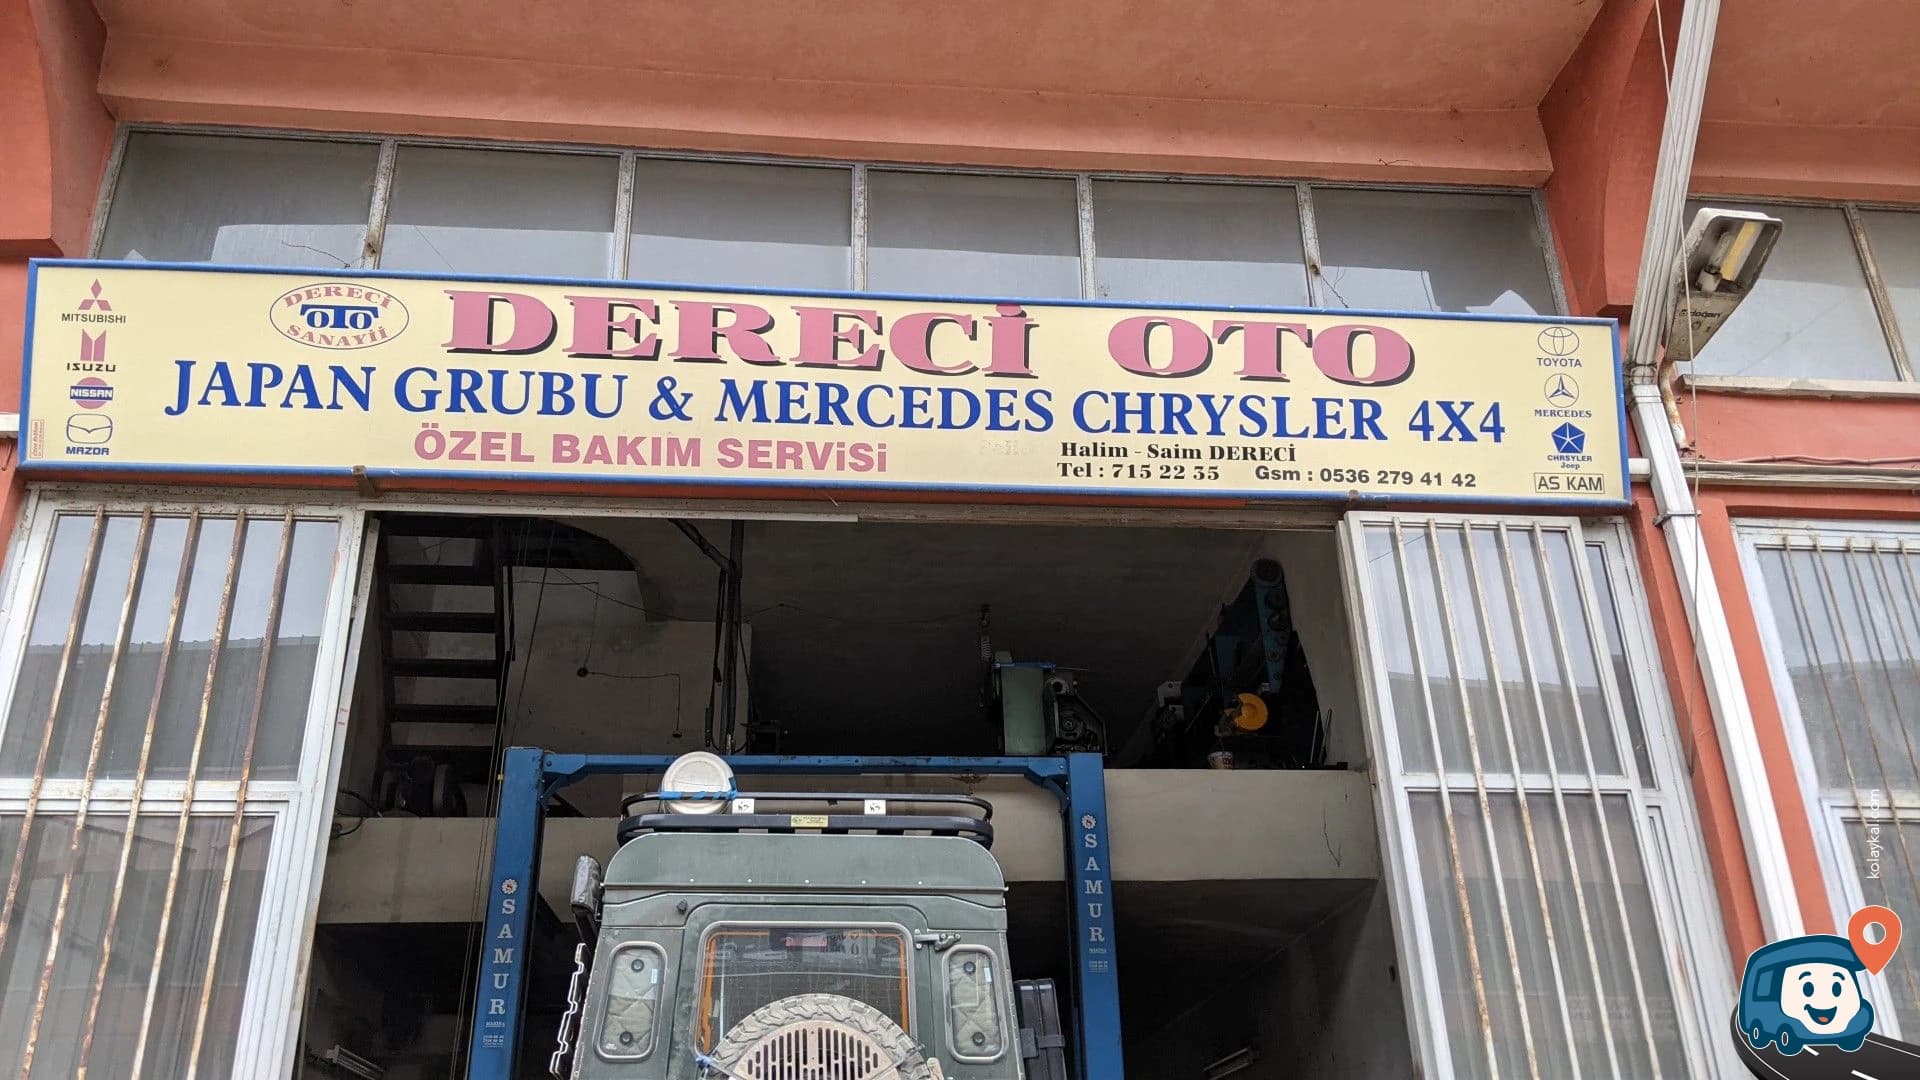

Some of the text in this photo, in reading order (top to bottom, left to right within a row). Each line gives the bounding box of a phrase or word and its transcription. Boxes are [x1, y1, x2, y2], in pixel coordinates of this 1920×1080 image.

[61, 312, 126, 324] MITSUBISHI
[441, 289, 1416, 388] DERECİ OTO
[66, 362, 117, 373] ISUZU
[1536, 357, 1583, 368] TOYOTA
[70, 387, 113, 398] NISSAN
[164, 359, 1506, 444] JAPAN GRUBU & MERCEDES CHRYSLER 4X4
[1533, 408, 1593, 419] MERCEDES
[65, 446, 110, 456] MAZDA
[413, 421, 536, 464] ÖZEL
[551, 432, 702, 468] BAKIM
[1060, 441, 1129, 458] Halim
[1147, 443, 1202, 460] Saim
[1209, 443, 1297, 462] DERECİ
[1056, 462, 1093, 478] Tel
[1112, 463, 1152, 479] 715
[1159, 464, 1186, 480] 22
[1560, 461, 1581, 471] Jeep
[1255, 465, 1301, 481] Gsm
[1319, 467, 1370, 484] 0536
[1377, 469, 1414, 485] 279
[1420, 471, 1443, 487] 41
[1451, 473, 1477, 488] 42
[1537, 475, 1604, 492] AS KAM
[1084, 833, 1105, 943] SAMUR
[487, 898, 517, 1016] SAMUR
